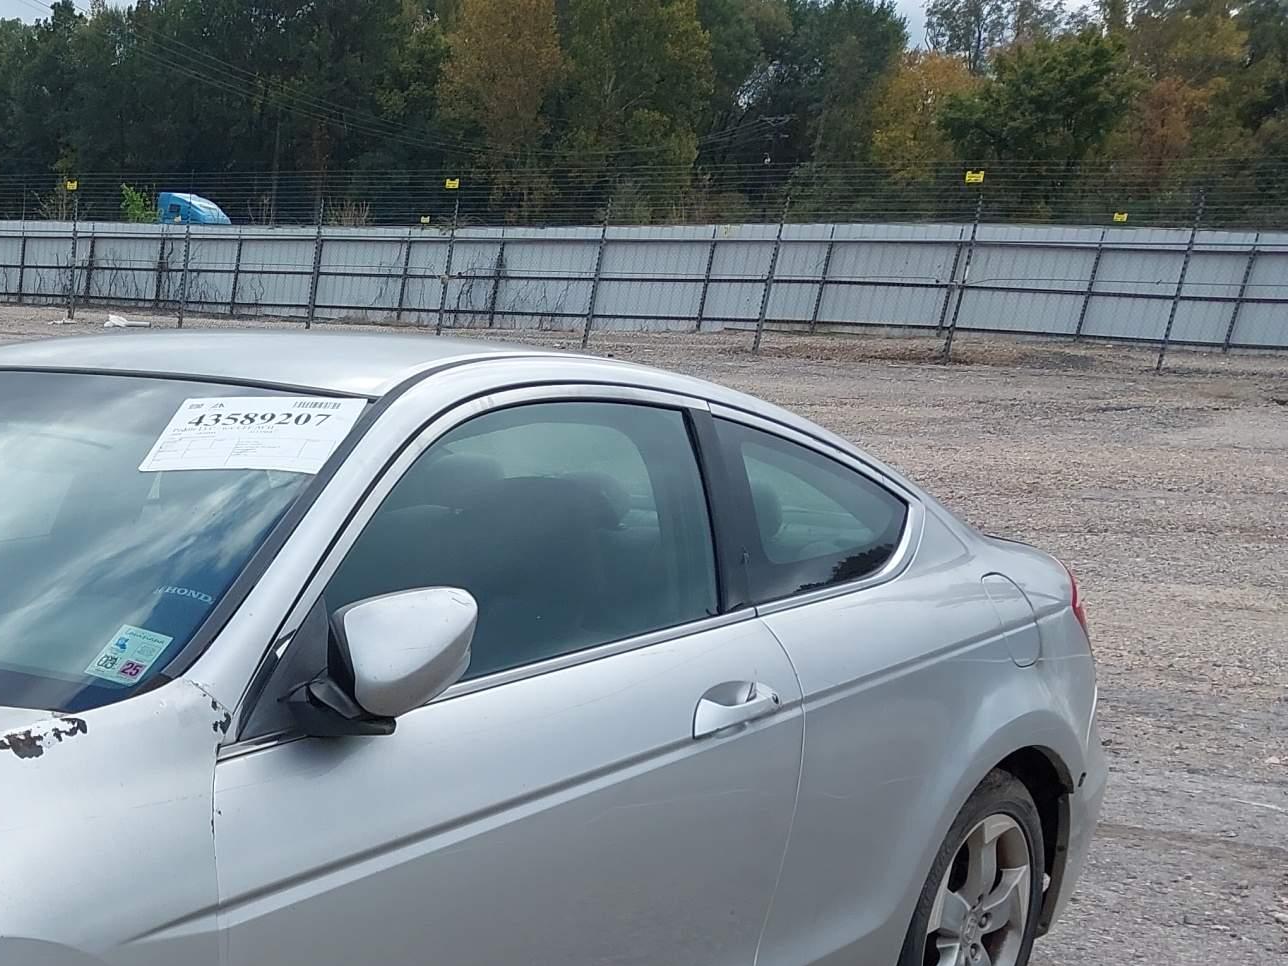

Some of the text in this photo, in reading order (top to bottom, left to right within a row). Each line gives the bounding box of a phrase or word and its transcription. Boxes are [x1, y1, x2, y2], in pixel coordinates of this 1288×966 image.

[187, 412, 332, 427] 43589207
[164, 586, 215, 605] HOND
[120, 662, 143, 677] 25
